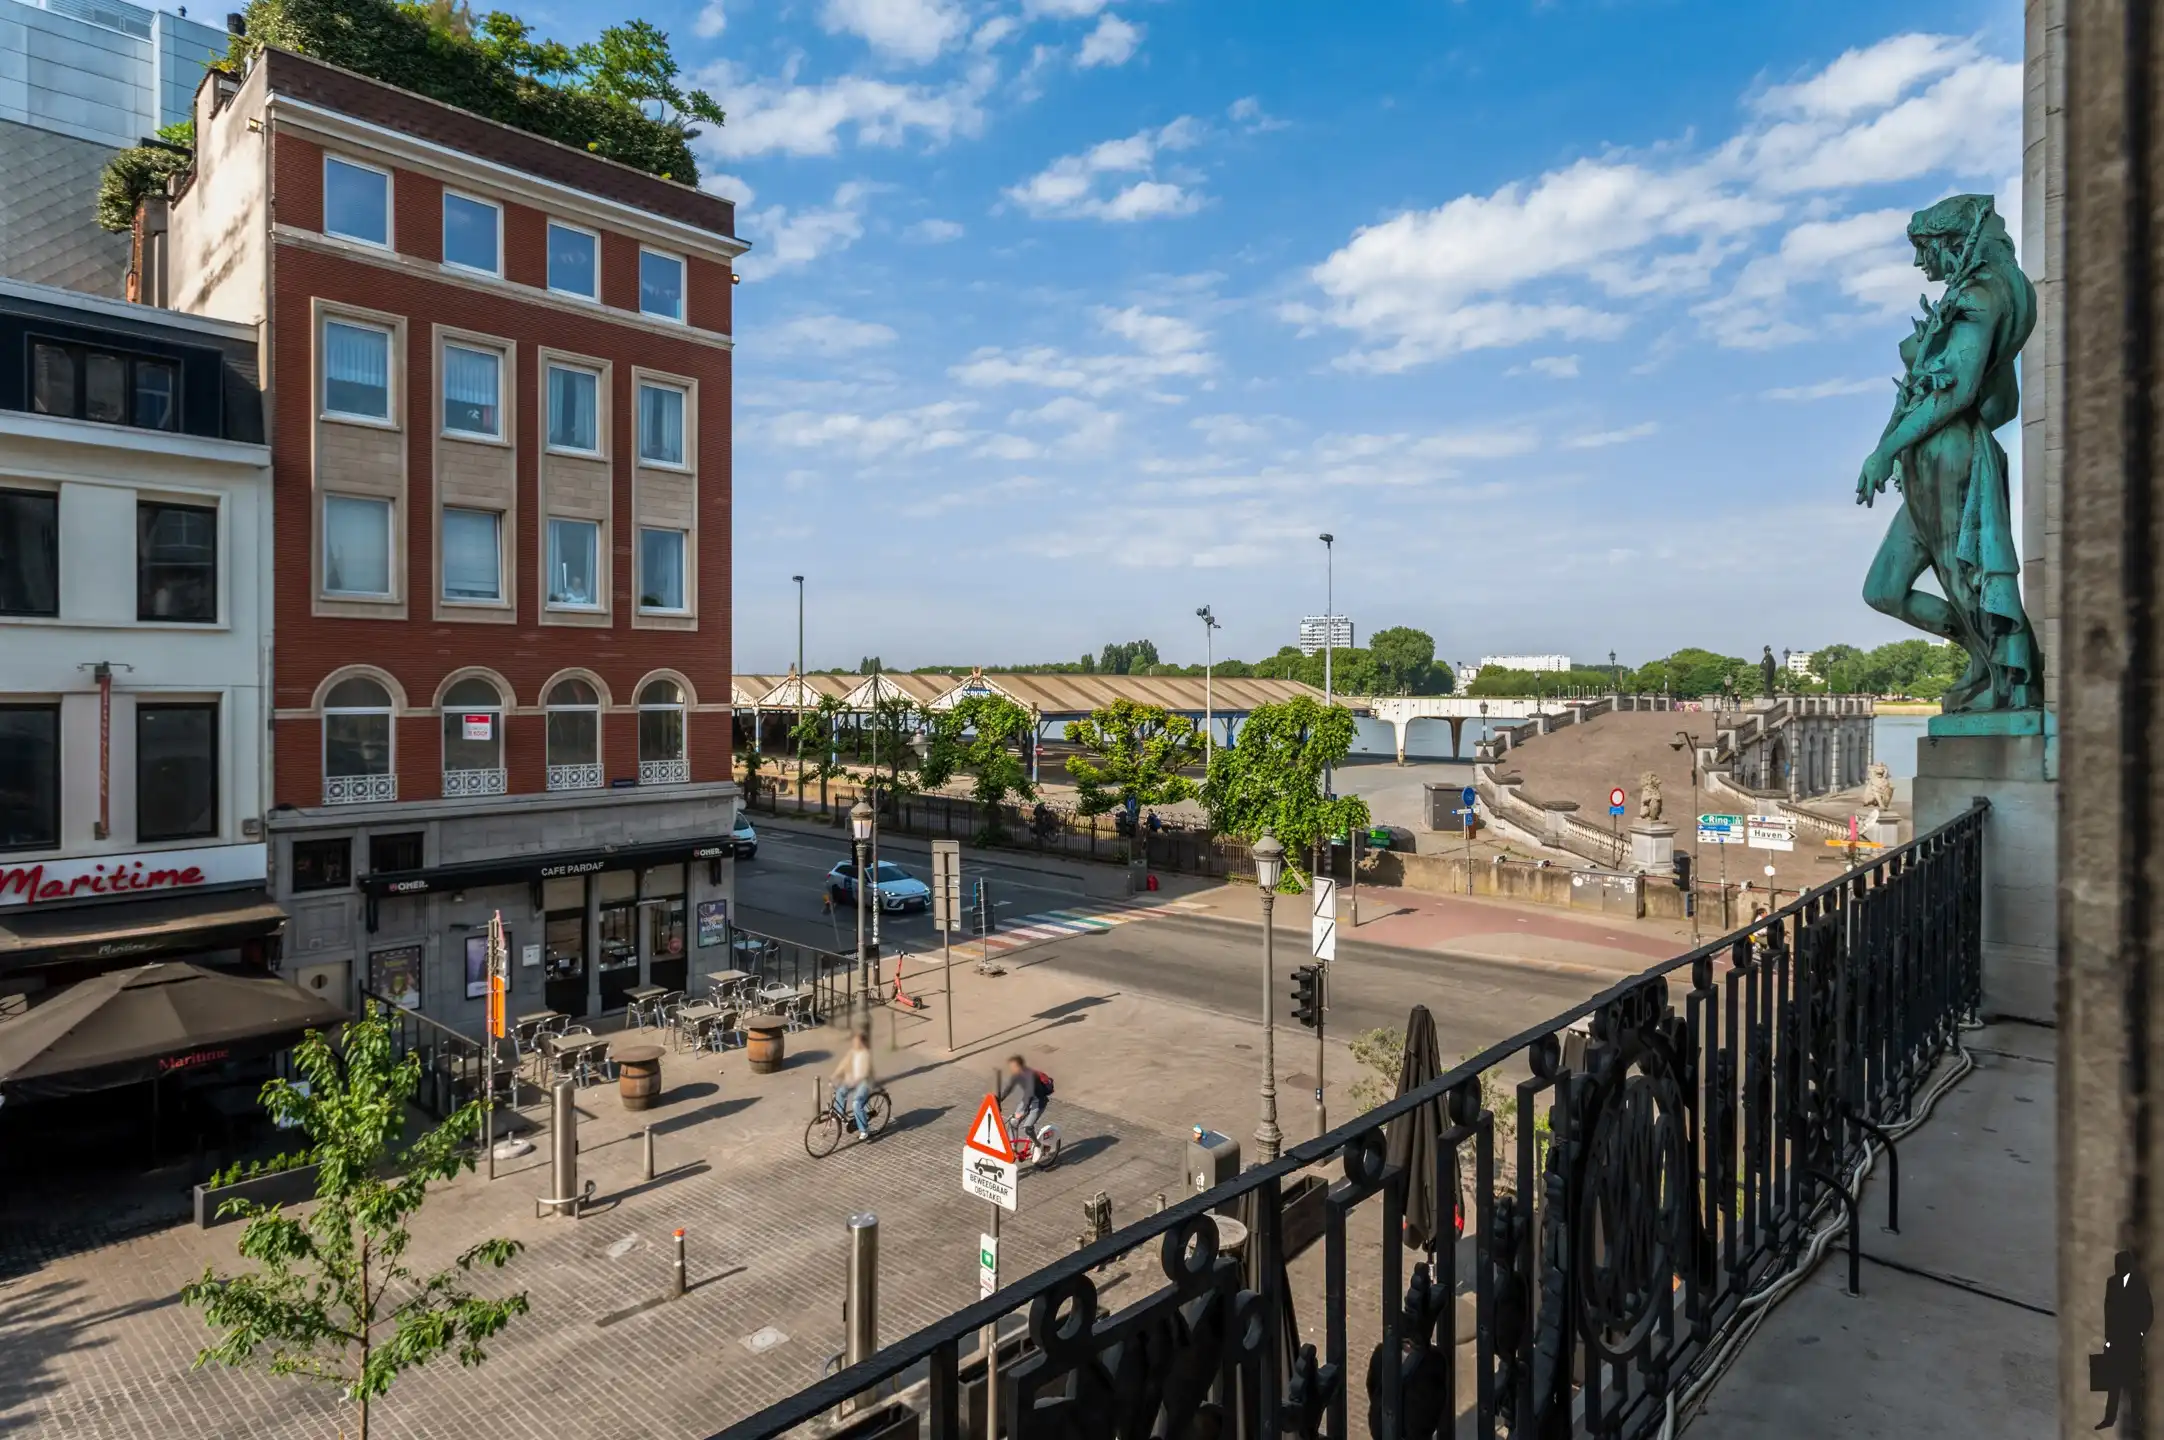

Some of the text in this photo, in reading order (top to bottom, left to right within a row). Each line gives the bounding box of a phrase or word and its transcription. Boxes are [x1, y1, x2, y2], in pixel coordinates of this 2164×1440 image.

[1708, 815, 1728, 825] Ring
[1754, 829, 1783, 838] Haven
[541, 861, 604, 876] CAFE PARDAF
[0, 861, 205, 905] Maritime
[158, 1050, 229, 1070] Maritime
[969, 1174, 1008, 1196] BEWEEGBAAR
[975, 1186, 1003, 1204] OBSTAKEL
